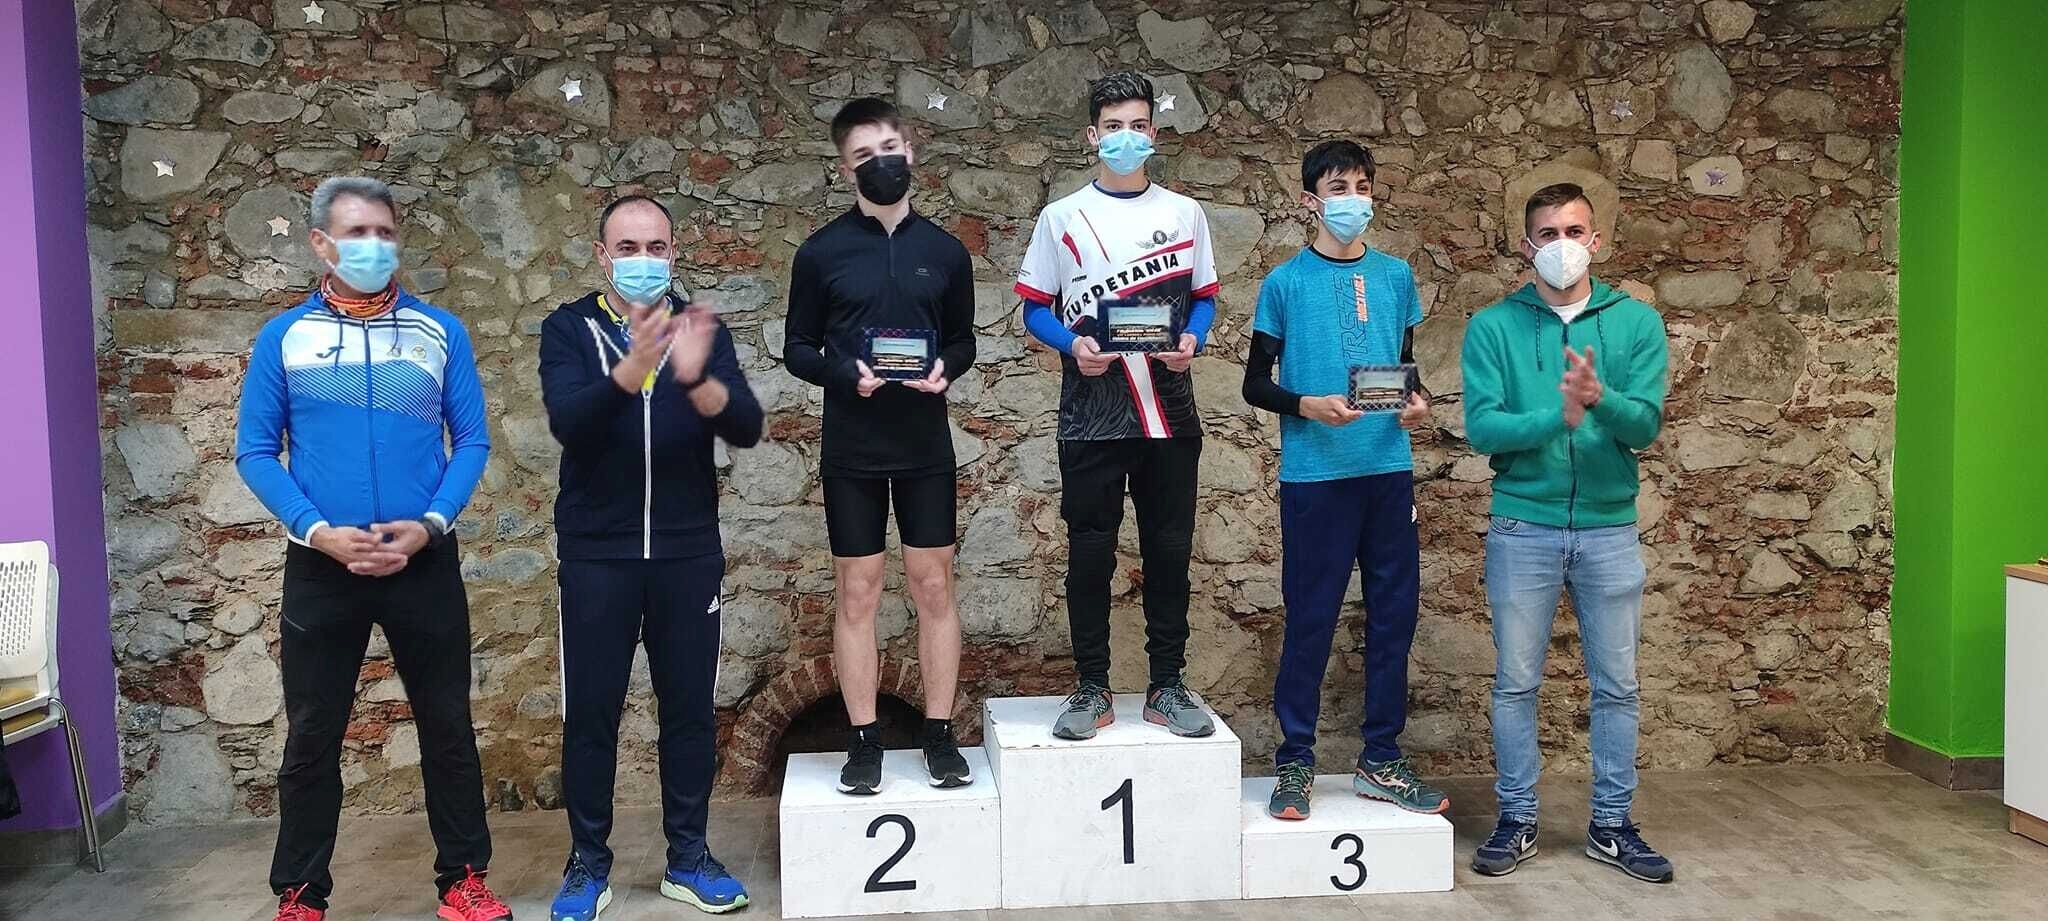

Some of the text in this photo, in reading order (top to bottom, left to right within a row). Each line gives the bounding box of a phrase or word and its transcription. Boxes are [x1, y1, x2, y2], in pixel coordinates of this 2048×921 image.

[1066, 253, 1179, 322] TURDETANIA
[864, 814, 916, 893] 2
[1101, 778, 1135, 864] 1
[1330, 833, 1367, 891] 3
